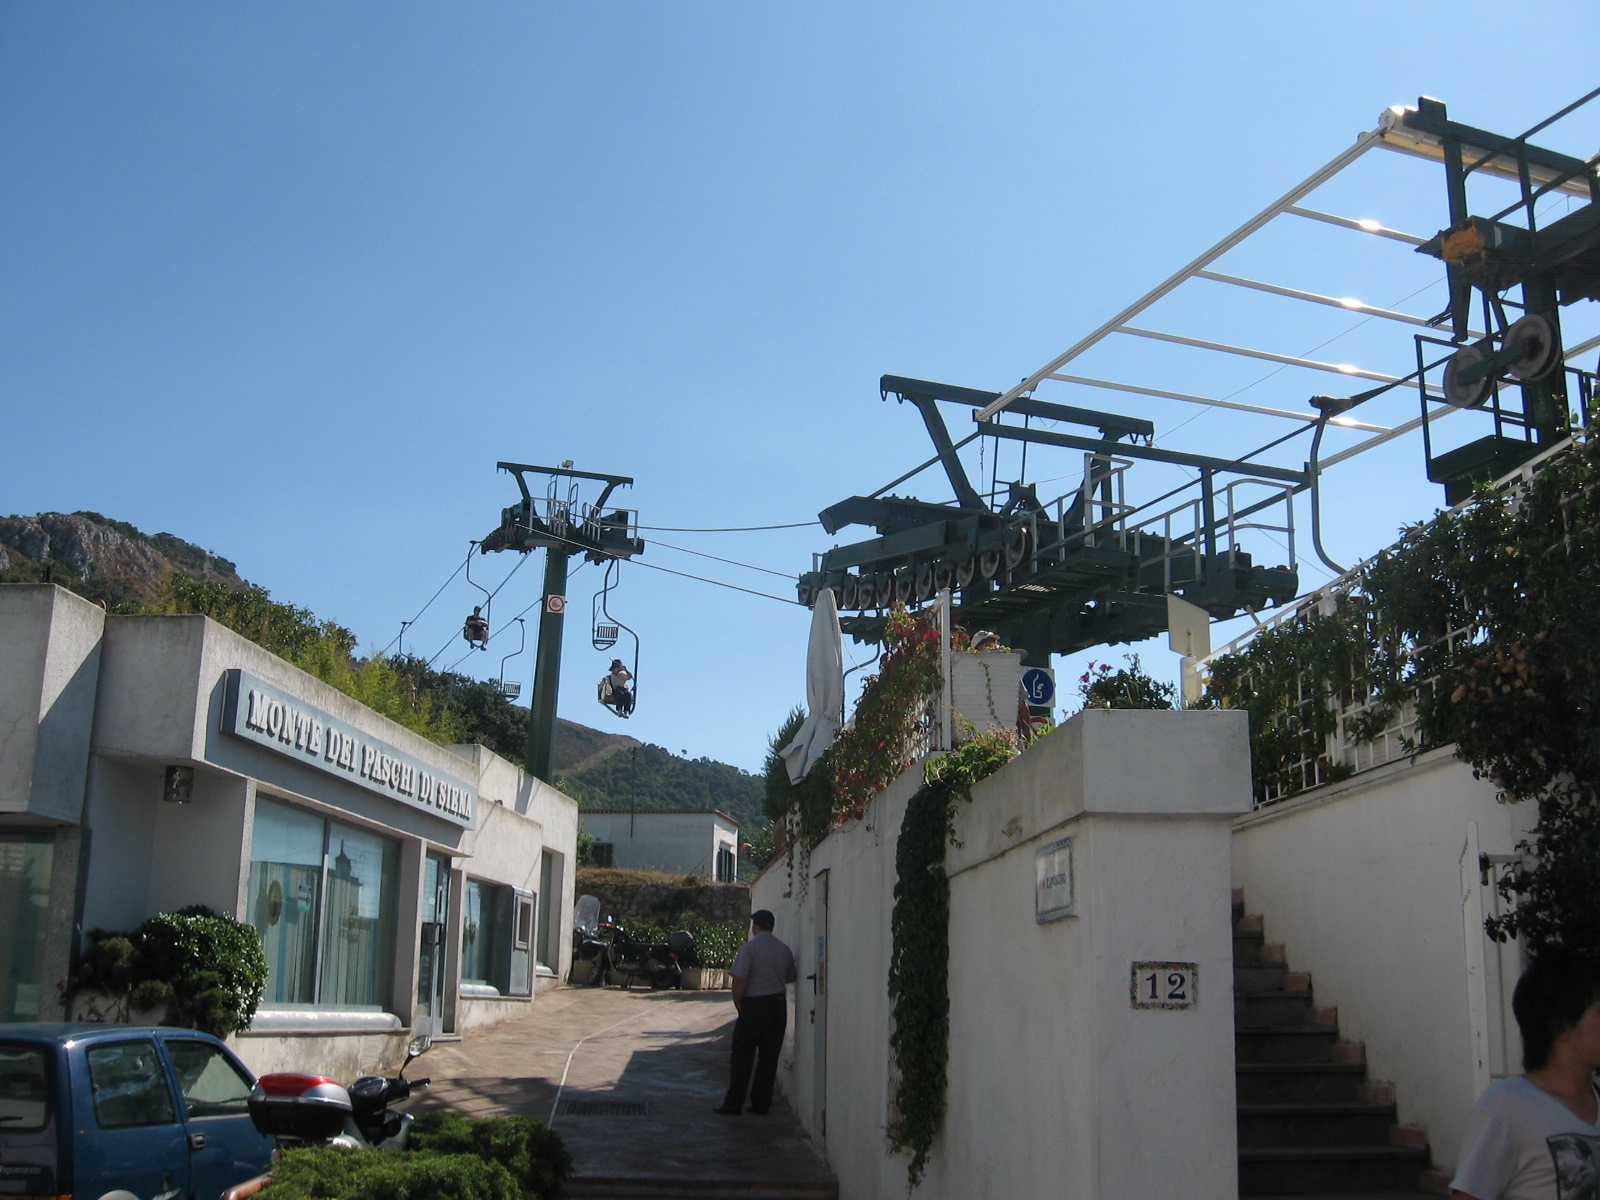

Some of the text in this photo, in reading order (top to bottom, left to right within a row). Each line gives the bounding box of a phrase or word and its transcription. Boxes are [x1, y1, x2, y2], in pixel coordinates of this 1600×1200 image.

[247, 689, 472, 821] MONTE DEI PASCHI DI SIENA
[1145, 972, 1187, 1000] 12
